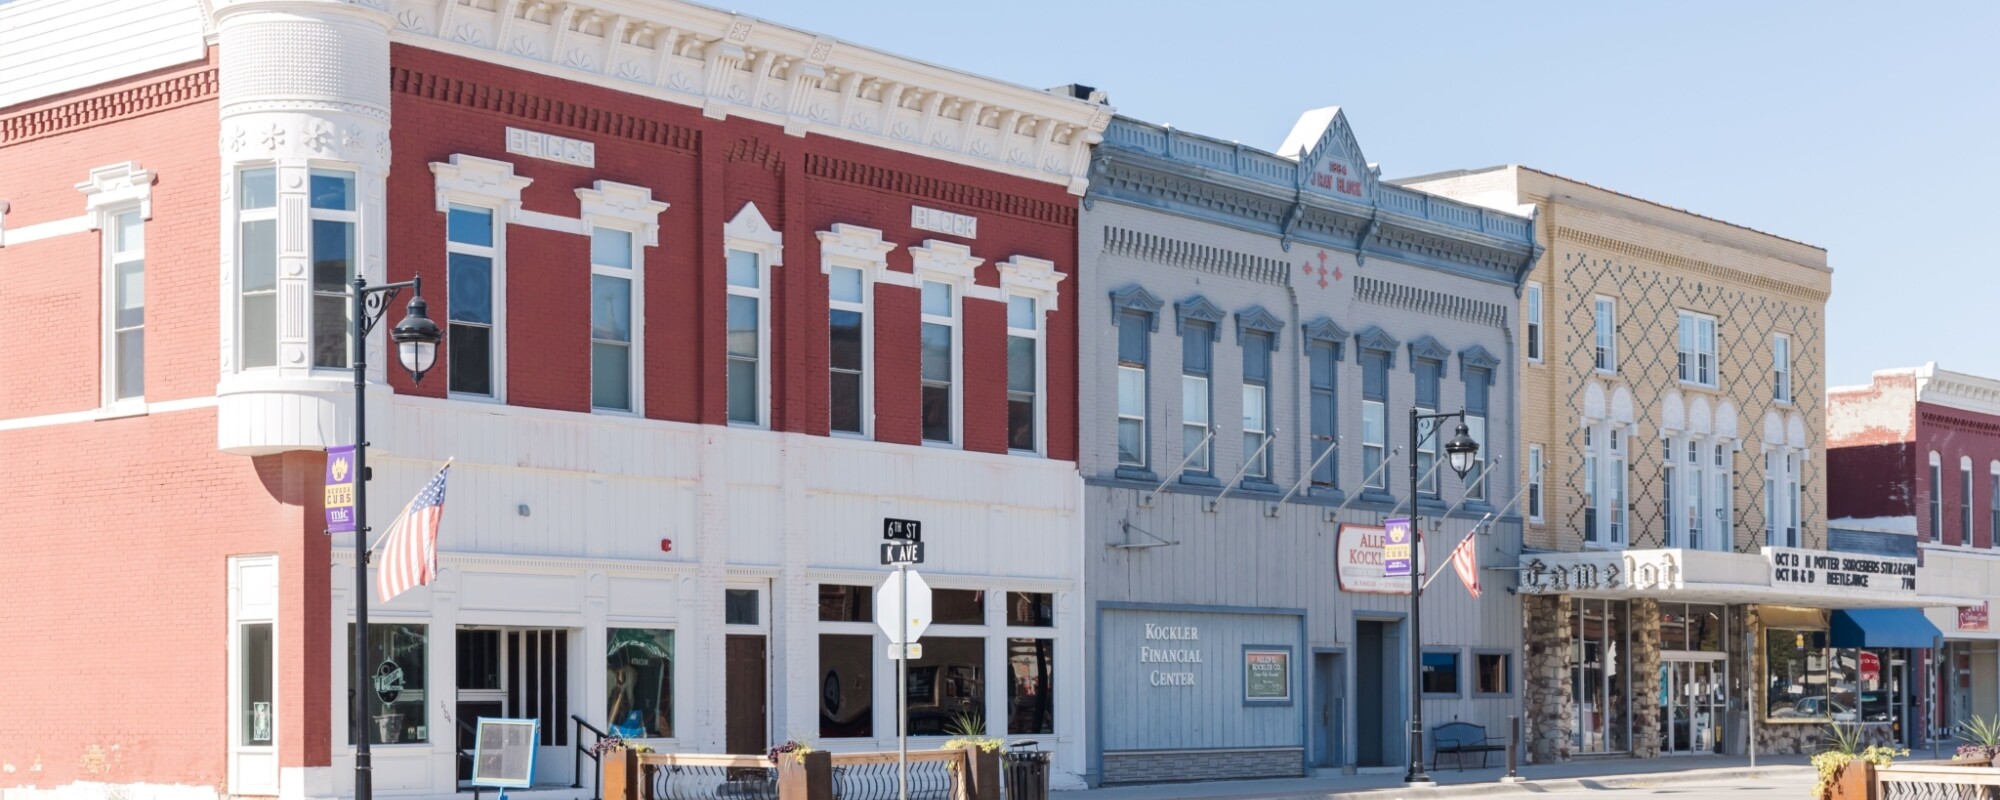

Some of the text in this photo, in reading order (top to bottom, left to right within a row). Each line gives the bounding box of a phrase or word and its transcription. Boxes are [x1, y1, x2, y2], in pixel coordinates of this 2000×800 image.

[914, 207, 976, 237] BLOCK
[327, 494, 352, 505] CUBS
[888, 521, 917, 540] 6TH ST
[1360, 533, 1386, 549] ALLE
[887, 544, 918, 562] K AVE
[1349, 549, 1385, 566] KOCKL
[1775, 553, 1790, 567] OCT
[1791, 554, 1799, 567] 13
[1814, 556, 1840, 571] POTTER
[1521, 553, 1675, 594] Camelot
[1775, 568, 1790, 582] OCT
[1826, 572, 1869, 588] BEETLEJUICE
[1145, 623, 1199, 640] KOCKLER
[1140, 646, 1203, 663] FINANCIAL
[1150, 670, 1195, 687] CENTER
